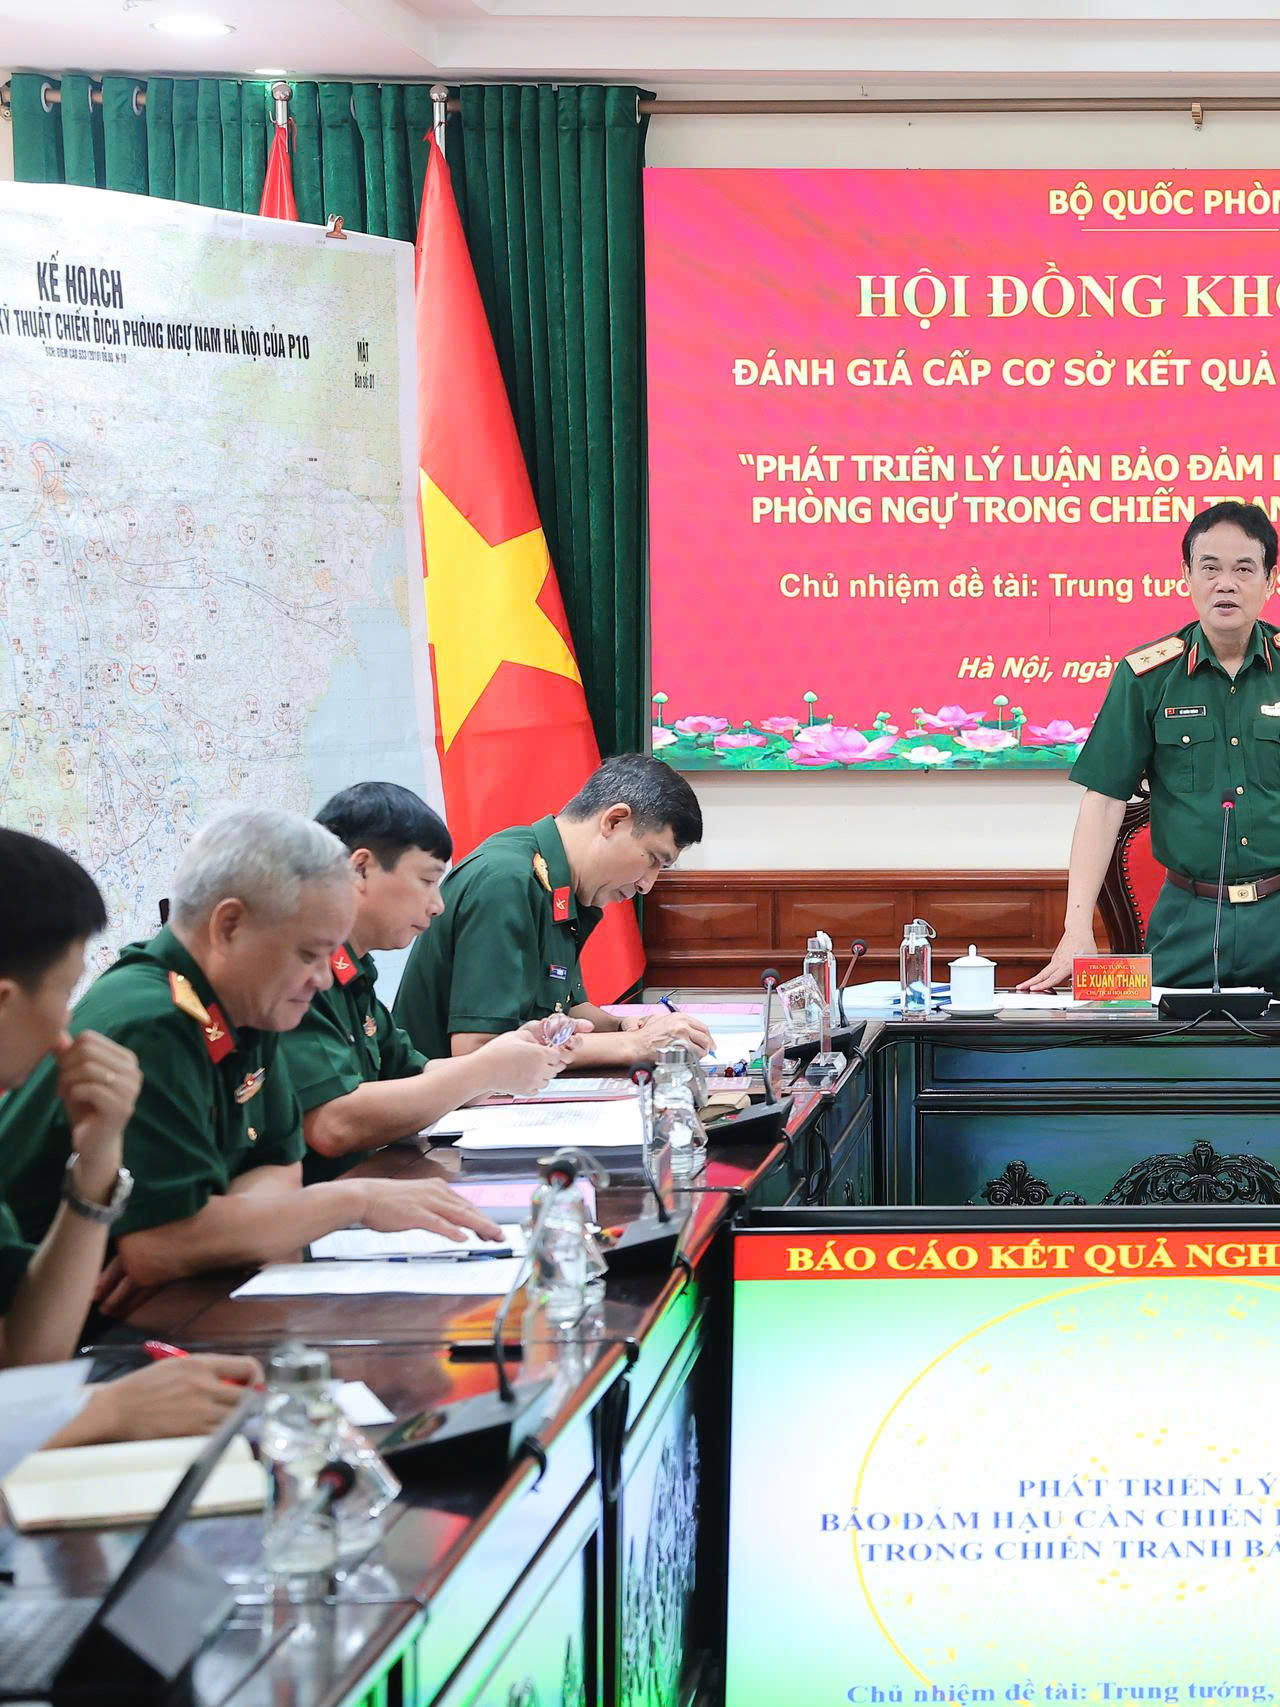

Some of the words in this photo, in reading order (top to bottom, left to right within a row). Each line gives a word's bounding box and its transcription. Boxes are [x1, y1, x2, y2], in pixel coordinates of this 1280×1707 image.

[1049, 182, 1093, 221] BỘ
[1102, 182, 1194, 220] QUỐC
[37, 250, 60, 302] KẾ
[65, 264, 124, 315] HOẠCH
[855, 267, 971, 330] HỘI
[986, 261, 1166, 318] ĐỒNG
[13, 306, 52, 344] THUẬT
[55, 307, 91, 342] CHIẾN
[94, 317, 121, 350] DỊCH
[123, 315, 163, 348] PHÒNG
[167, 323, 192, 356] NGỰ
[194, 326, 222, 353] NAM
[224, 325, 240, 355] HÀ
[241, 326, 261, 361] NỘI
[263, 324, 286, 358] CỦA
[288, 334, 310, 360] P10
[732, 349, 835, 386] ĐÁNH
[846, 349, 913, 387] GIÁ
[922, 350, 992, 387] CẤP
[1002, 359, 1056, 387] CƠ
[1064, 350, 1116, 387] SỞ
[1126, 349, 1192, 386] KẾT
[1200, 350, 1277, 392] QUẢ
[851, 446, 955, 482] TRIỂN
[965, 445, 1005, 482] LÝ
[1013, 446, 1101, 488] LUẬN
[1111, 446, 1180, 482] BẢO
[1186, 446, 1263, 481] ĐẢM
[752, 488, 872, 524] PHÒNG
[881, 492, 959, 530] NGỰ
[962, 495, 1081, 524] TRONG
[1089, 487, 1195, 524] CHIẾN
[779, 572, 839, 598] Chủ
[849, 573, 939, 604] nhiệm
[948, 567, 984, 598] đề
[992, 572, 1038, 598] tài:
[1048, 573, 1133, 604] Trung
[957, 655, 995, 679] Hà
[1001, 655, 1054, 684] Nội,
[1061, 654, 1119, 684] ngà
[1076, 969, 1087, 988] LÊ
[1089, 970, 1114, 988] XUÂN
[786, 1240, 877, 1272] BÁO
[886, 1239, 979, 1271] CÁO
[988, 1238, 1075, 1270] KẾT
[1084, 1237, 1177, 1273] QUẢ
[1018, 1474, 1108, 1498] PHÁT
[1234, 1472, 1277, 1496] LÝ
[860, 1542, 983, 1562] TRONG
[1113, 1540, 1232, 1559] TRANH
[914, 1683, 995, 1706] nhiệm
[1045, 1682, 1087, 1700] tài:
[1097, 1681, 1179, 1703] Trung
[1188, 1681, 1275, 1702] tướng,
